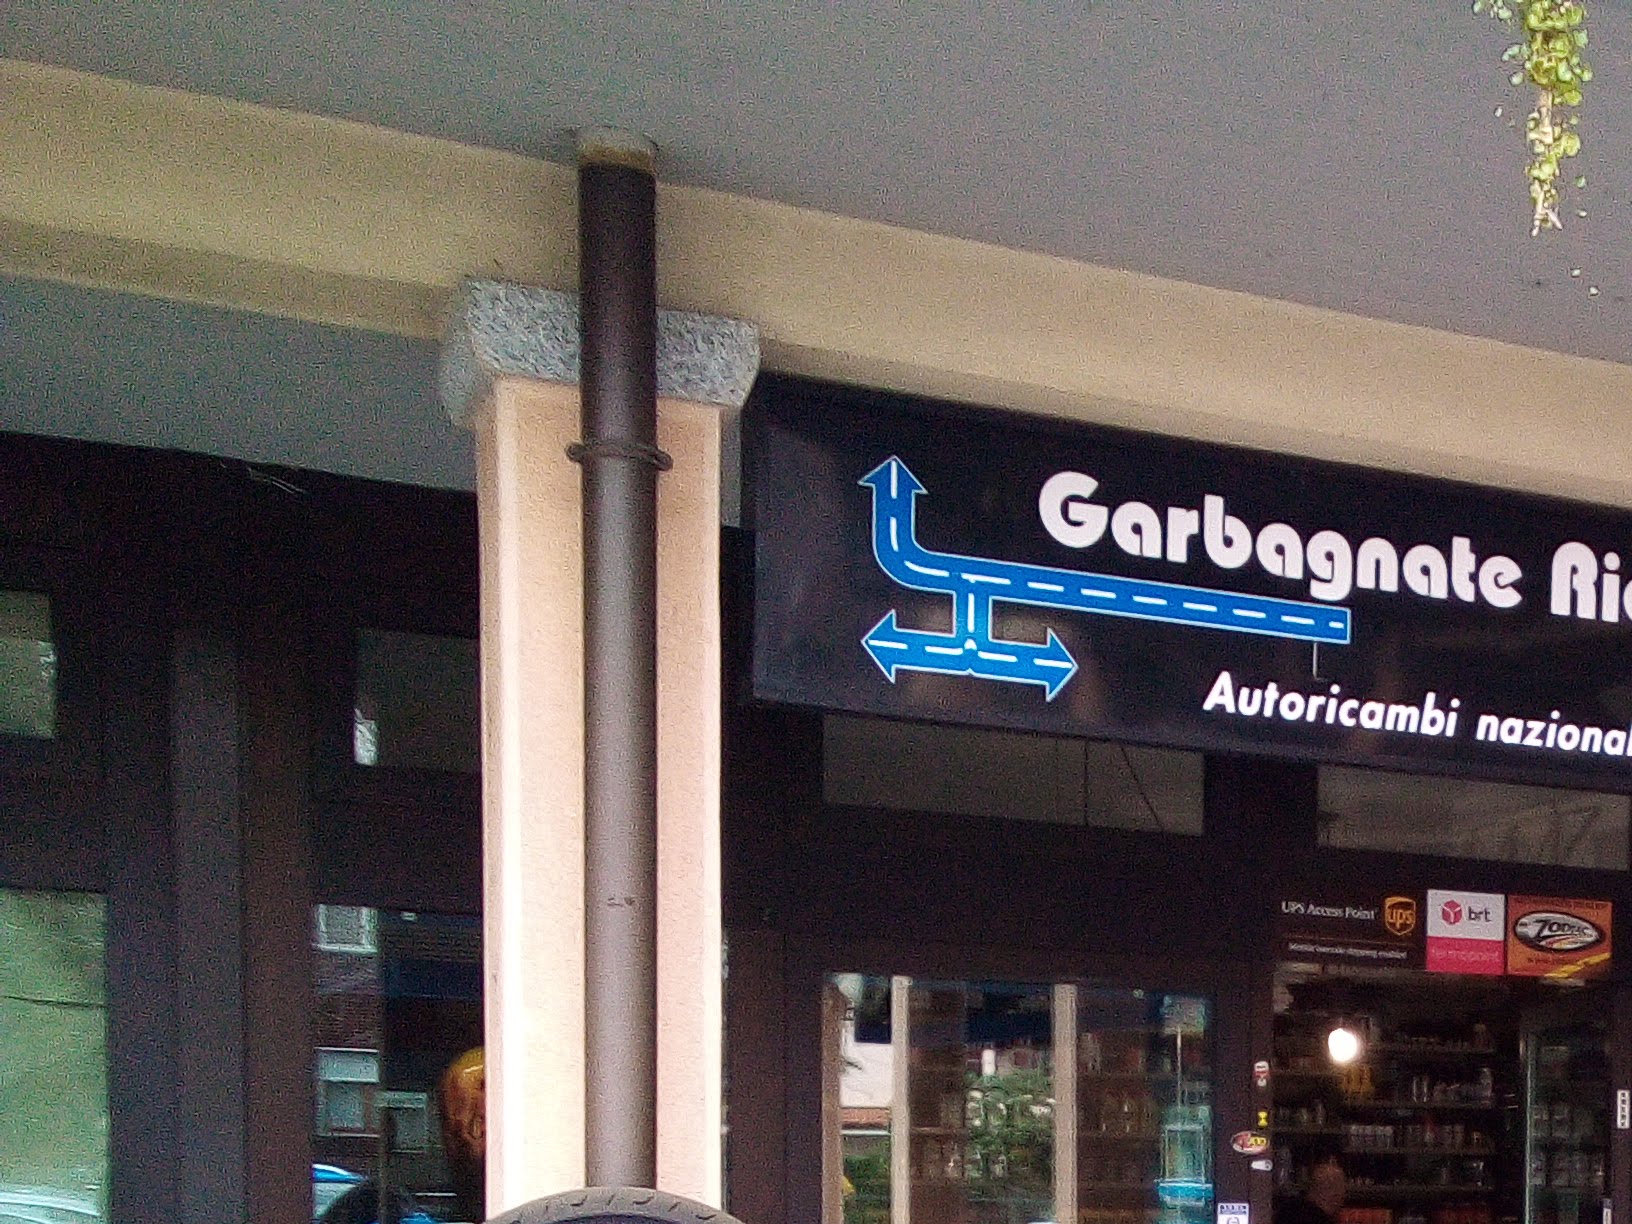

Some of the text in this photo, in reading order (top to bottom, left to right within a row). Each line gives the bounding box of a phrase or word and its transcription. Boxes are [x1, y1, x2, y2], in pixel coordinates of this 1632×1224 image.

[1038, 470, 1523, 608] Garbagnate
[1202, 670, 1461, 737] Autoricambi
[1306, 904, 1344, 917] Access
[1345, 906, 1376, 920] Point
[1388, 909, 1414, 929] ups
[1467, 906, 1492, 922] brt
